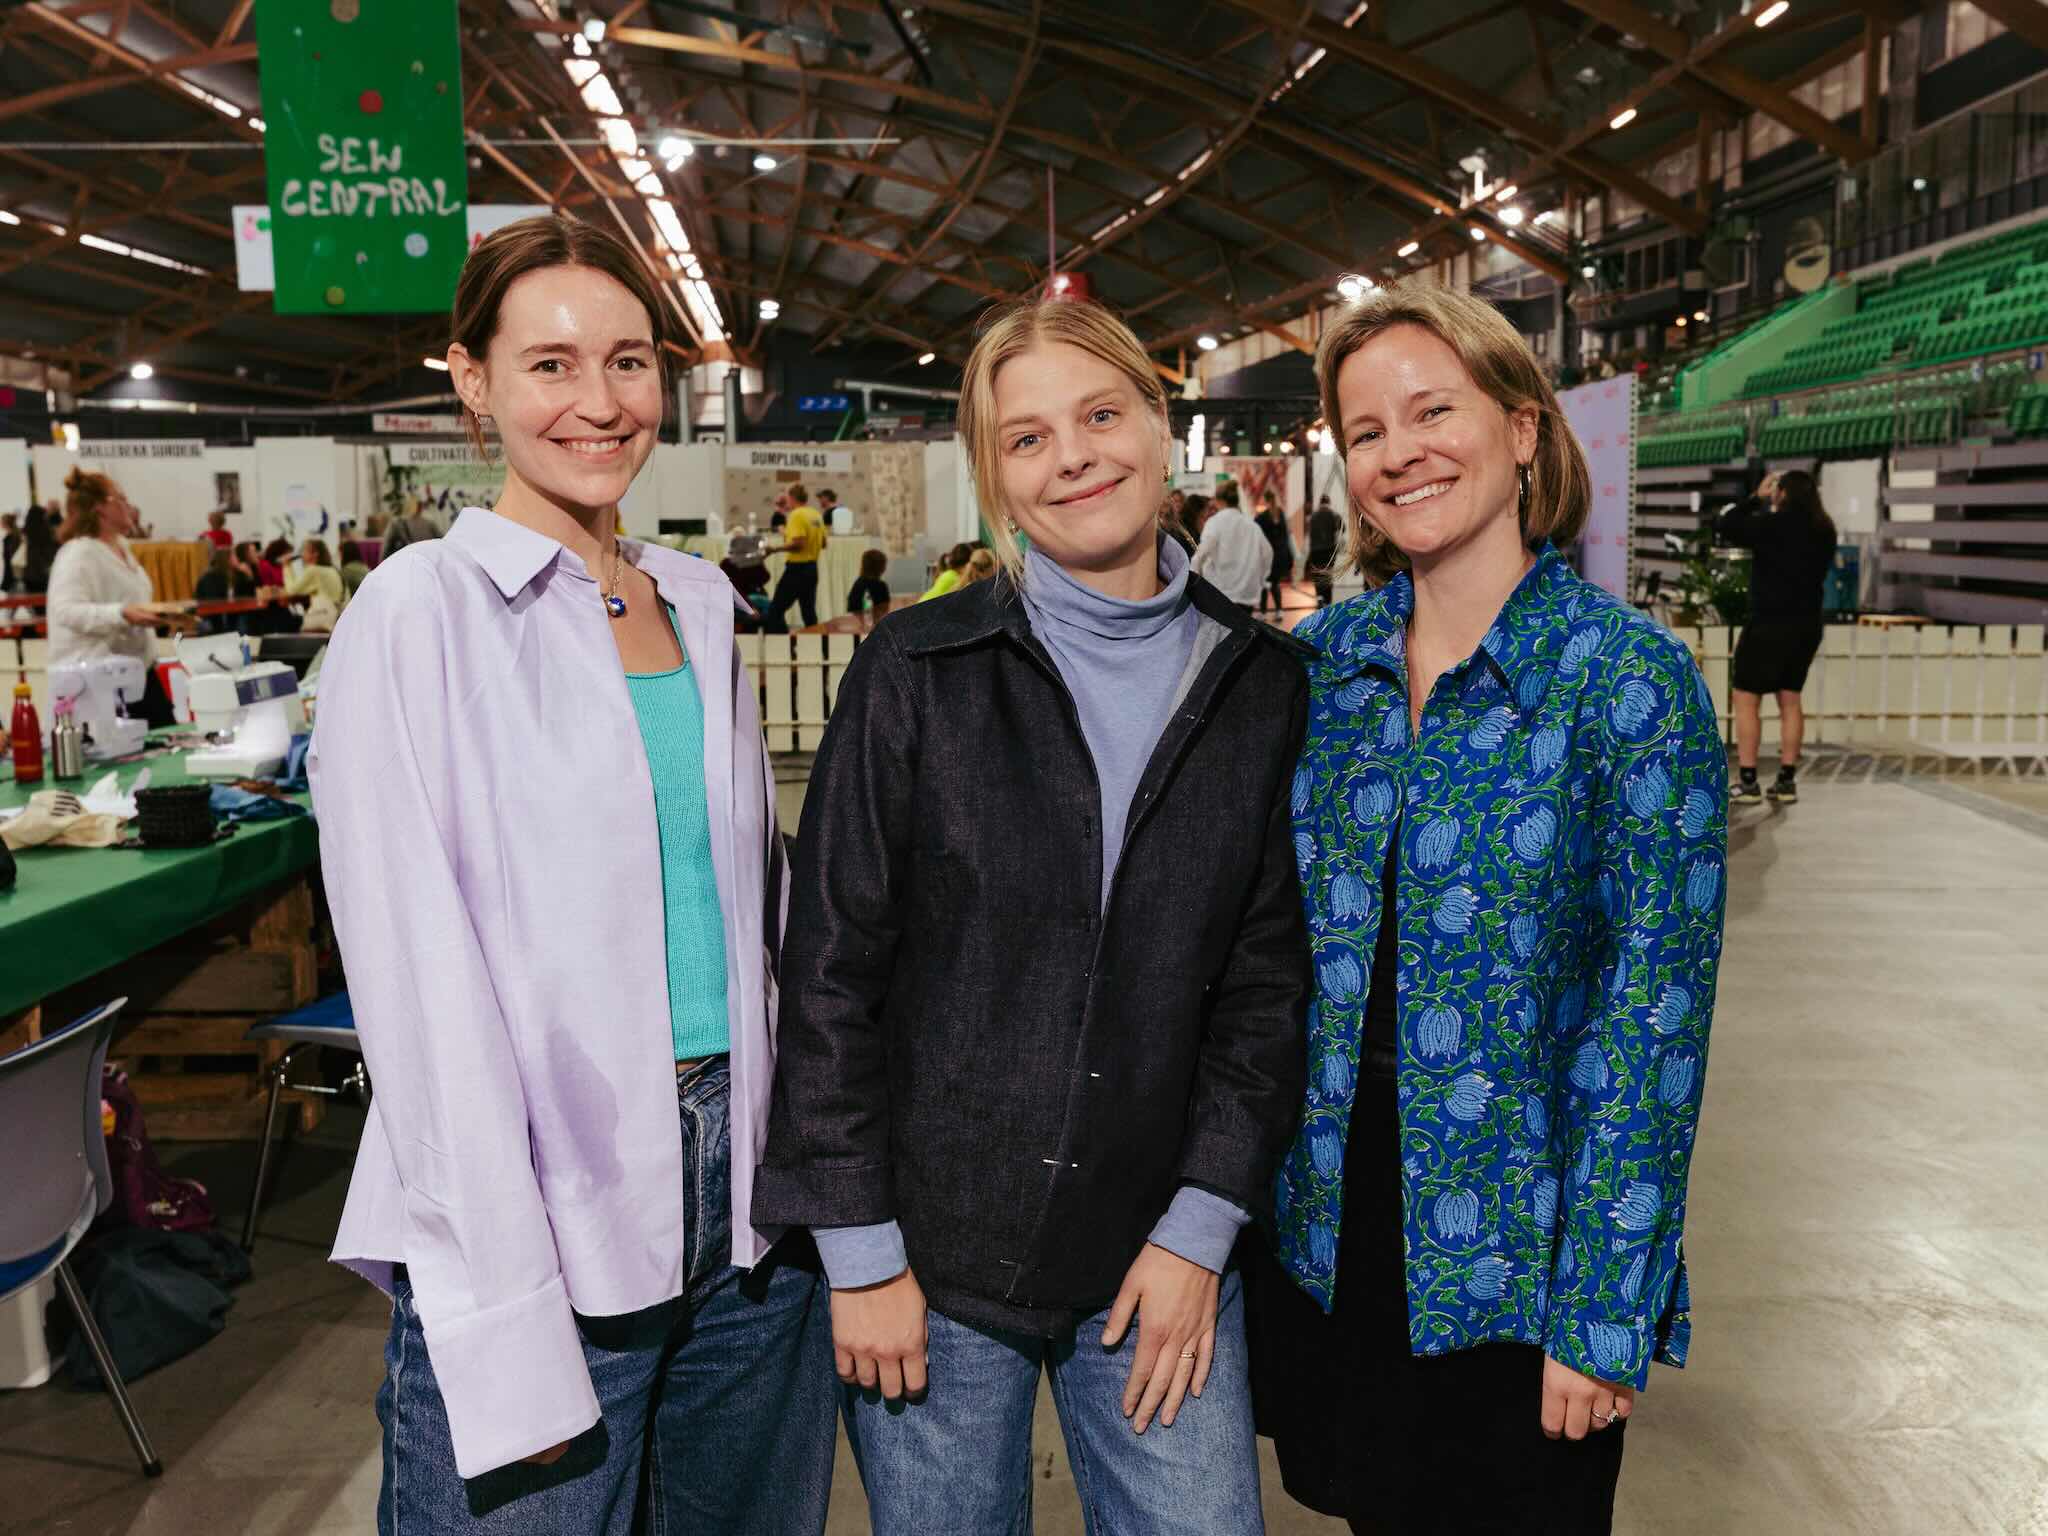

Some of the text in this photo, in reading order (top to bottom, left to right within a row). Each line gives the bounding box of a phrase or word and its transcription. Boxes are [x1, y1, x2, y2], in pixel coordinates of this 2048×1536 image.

[318, 133, 402, 174] SEW
[281, 176, 461, 217] CENTRAL
[409, 447, 467, 460] CULTIVATE
[751, 451, 827, 467] DUMPLING AS
